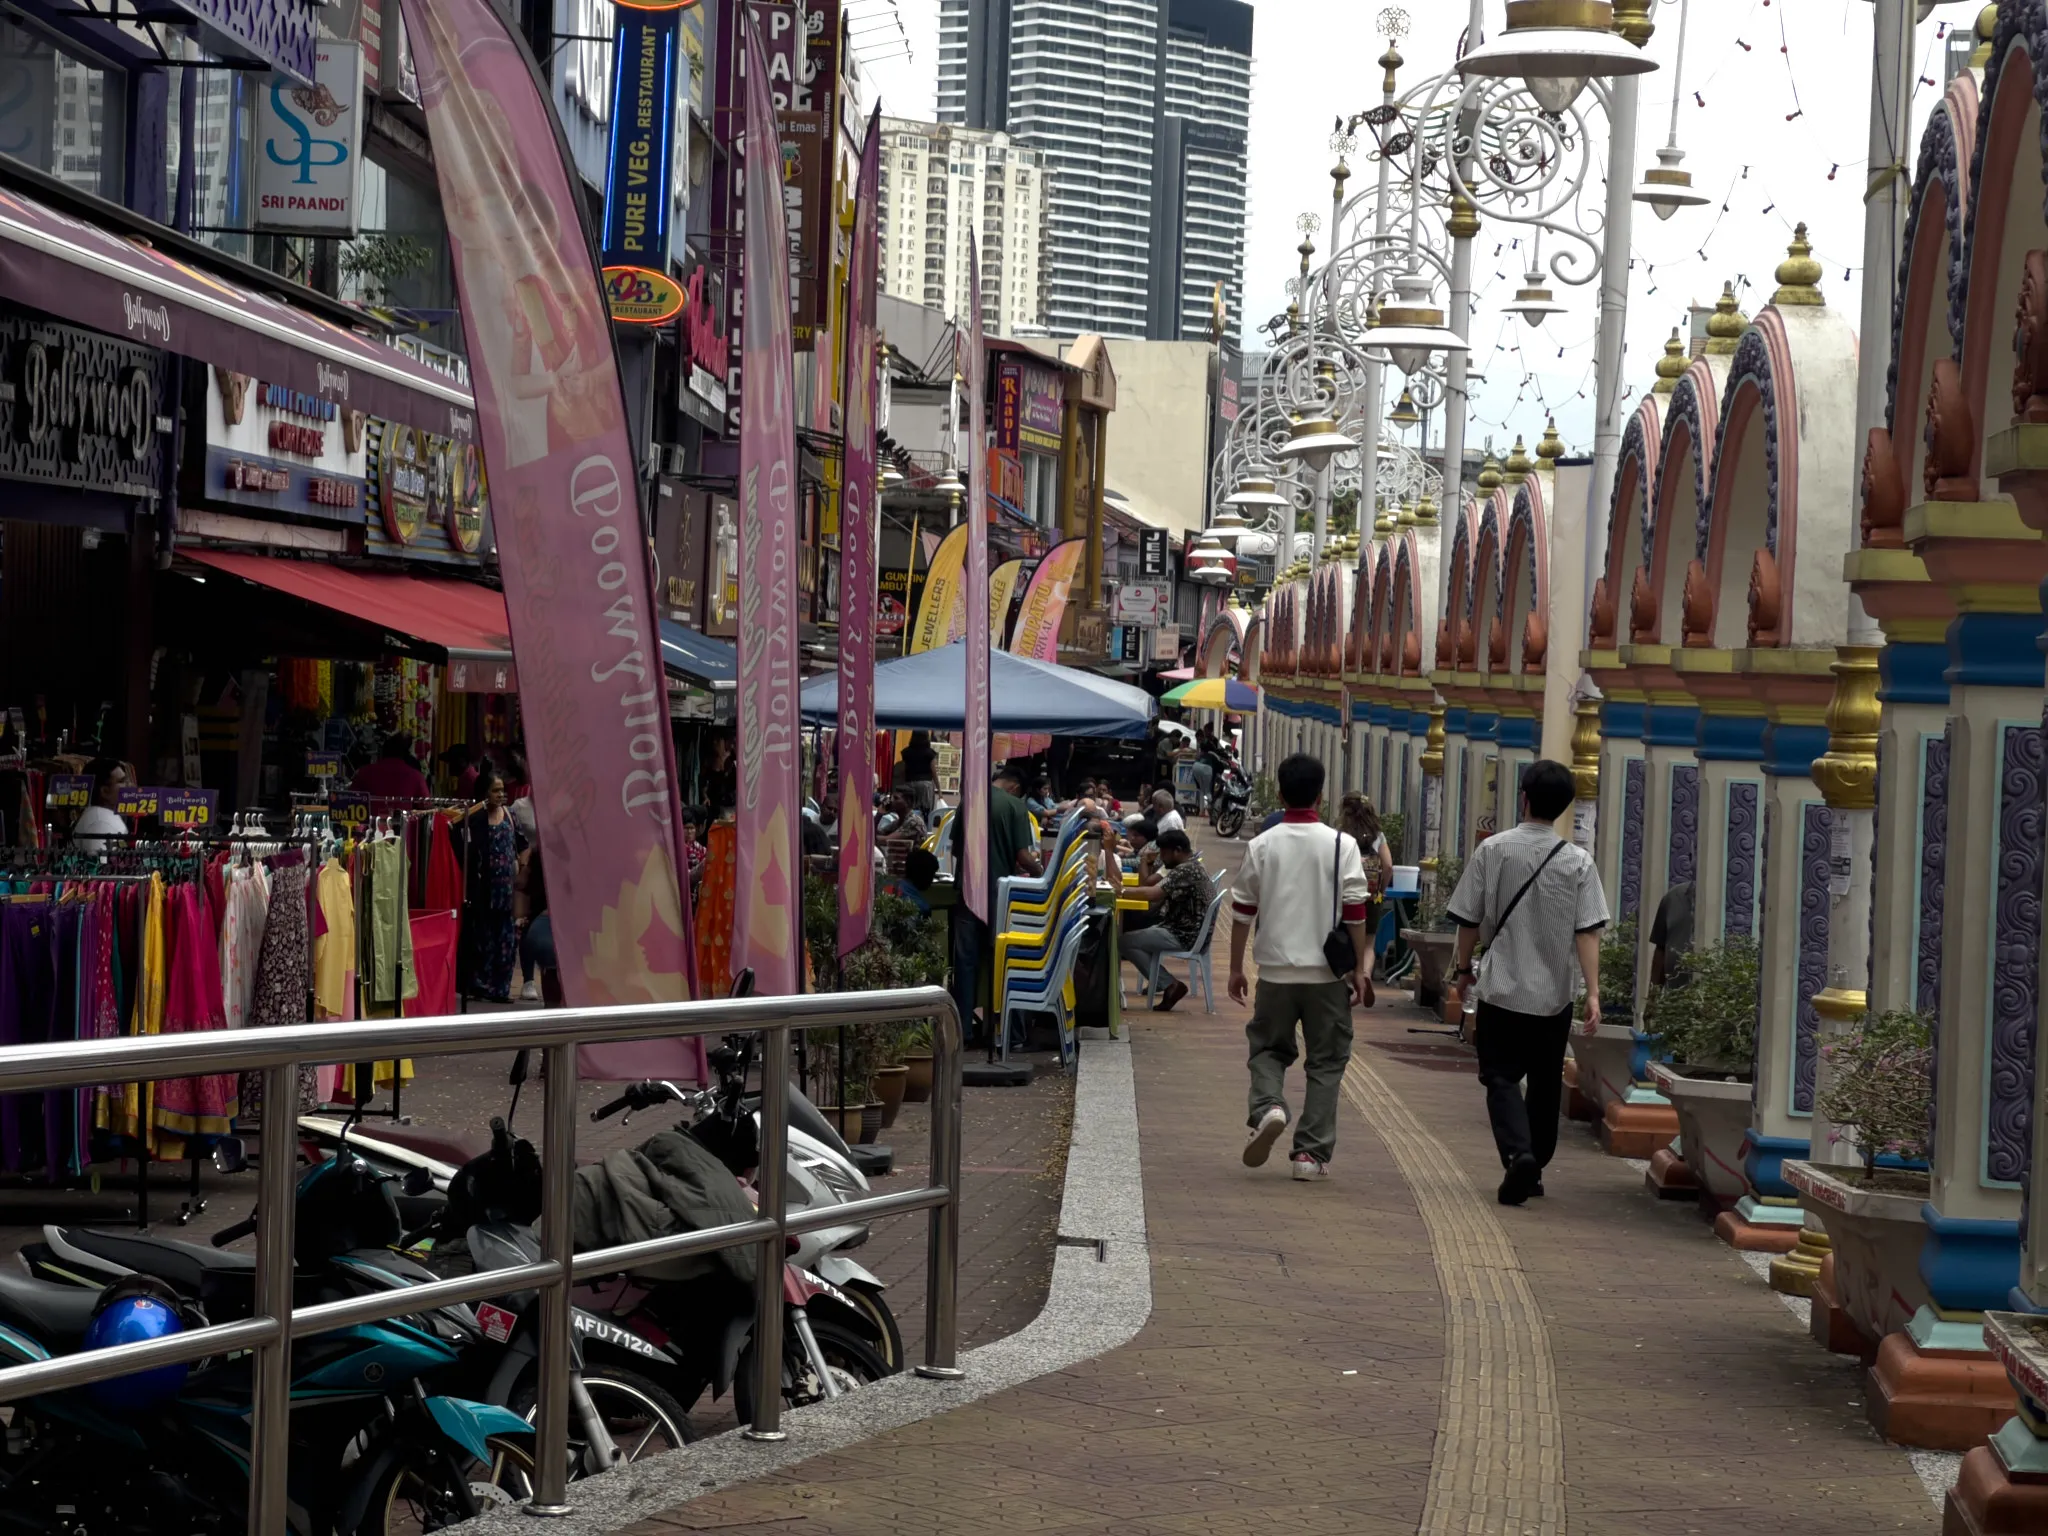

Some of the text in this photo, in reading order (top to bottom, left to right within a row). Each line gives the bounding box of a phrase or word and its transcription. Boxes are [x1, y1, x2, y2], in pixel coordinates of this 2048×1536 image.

[624, 25, 657, 251] PURE VEG. RESTAURANT
[790, 121, 816, 133] Emas
[261, 195, 345, 212] SRI PAANDI
[607, 271, 654, 302] A2B
[614, 305, 664, 316] RESTAURANT
[1145, 531, 1161, 573] JEEL
[885, 571, 925, 584] GUNIN
[920, 577, 946, 650] JEWELLERS
[1026, 583, 1051, 631] PATTU
[1032, 619, 1054, 660] RRIVAL
[1126, 626, 1136, 659] JEEL
[574, 1314, 654, 1356] AFU 7124
